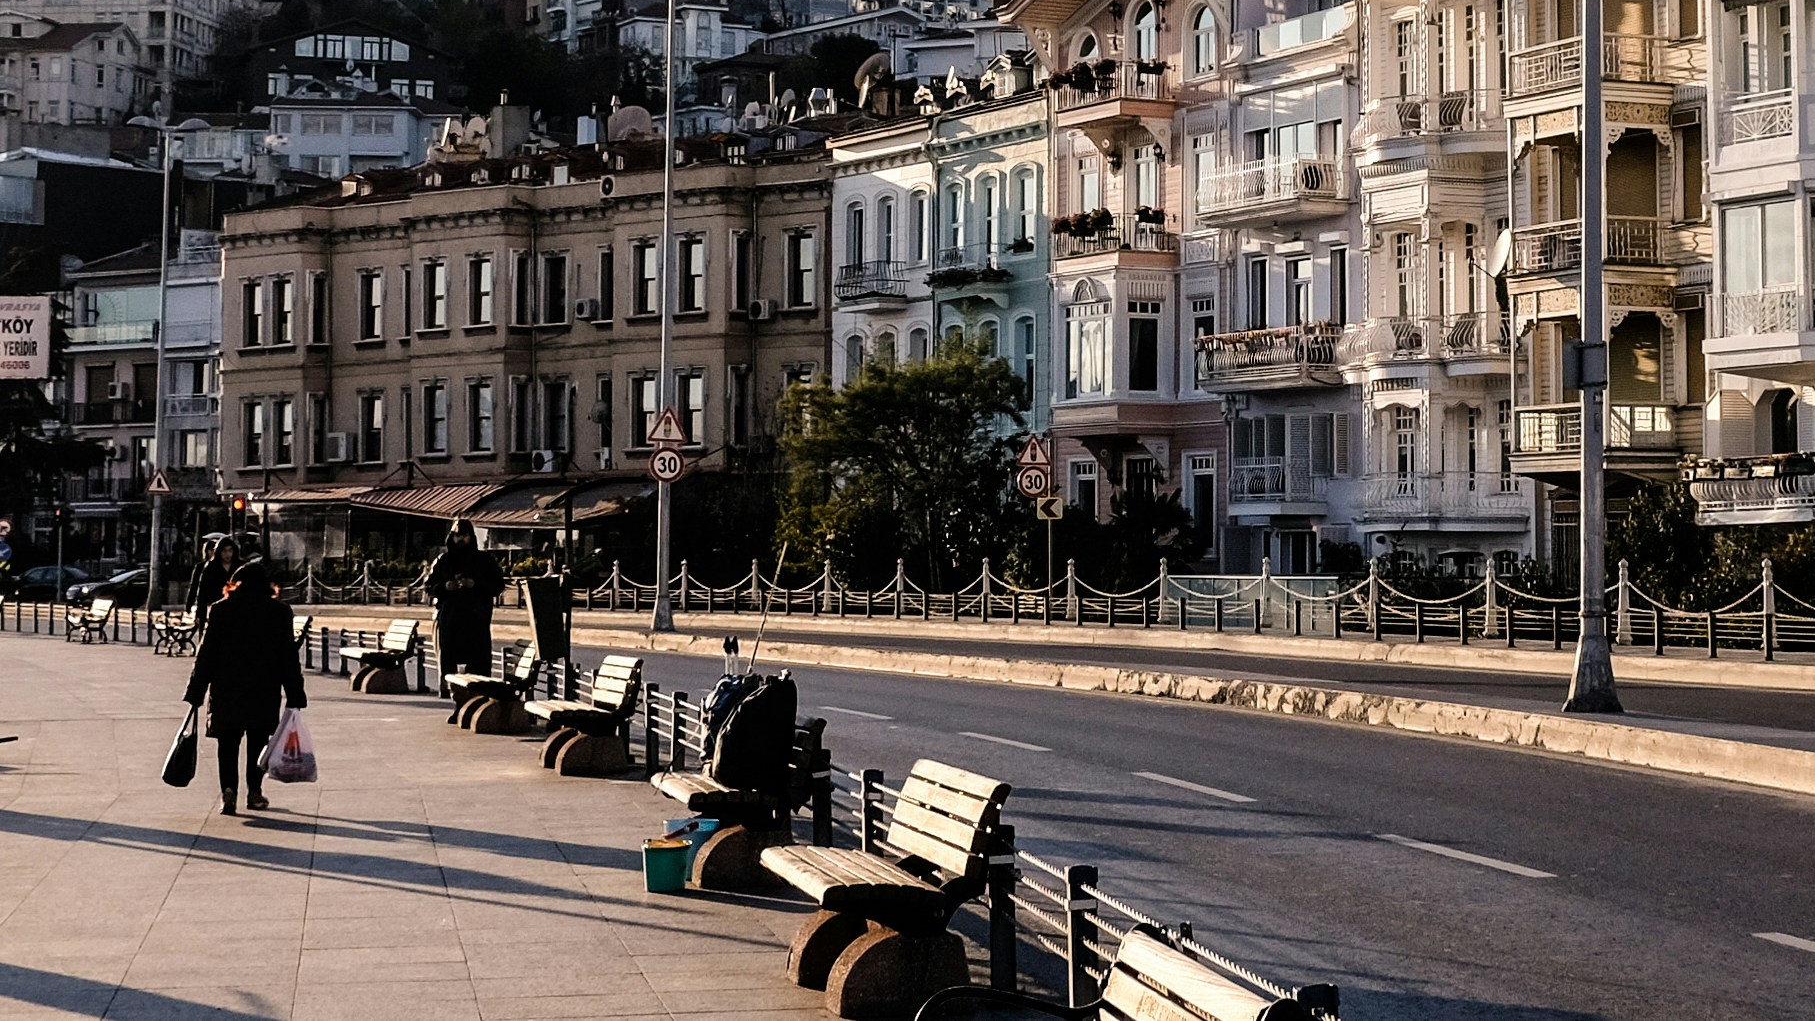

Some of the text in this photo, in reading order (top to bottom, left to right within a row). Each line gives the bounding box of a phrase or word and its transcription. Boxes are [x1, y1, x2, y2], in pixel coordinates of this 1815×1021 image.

[0, 316, 34, 334] KÖY
[3, 337, 38, 356] YERİDİR
[657, 456, 677, 473] 30
[1025, 474, 1043, 490] 30
